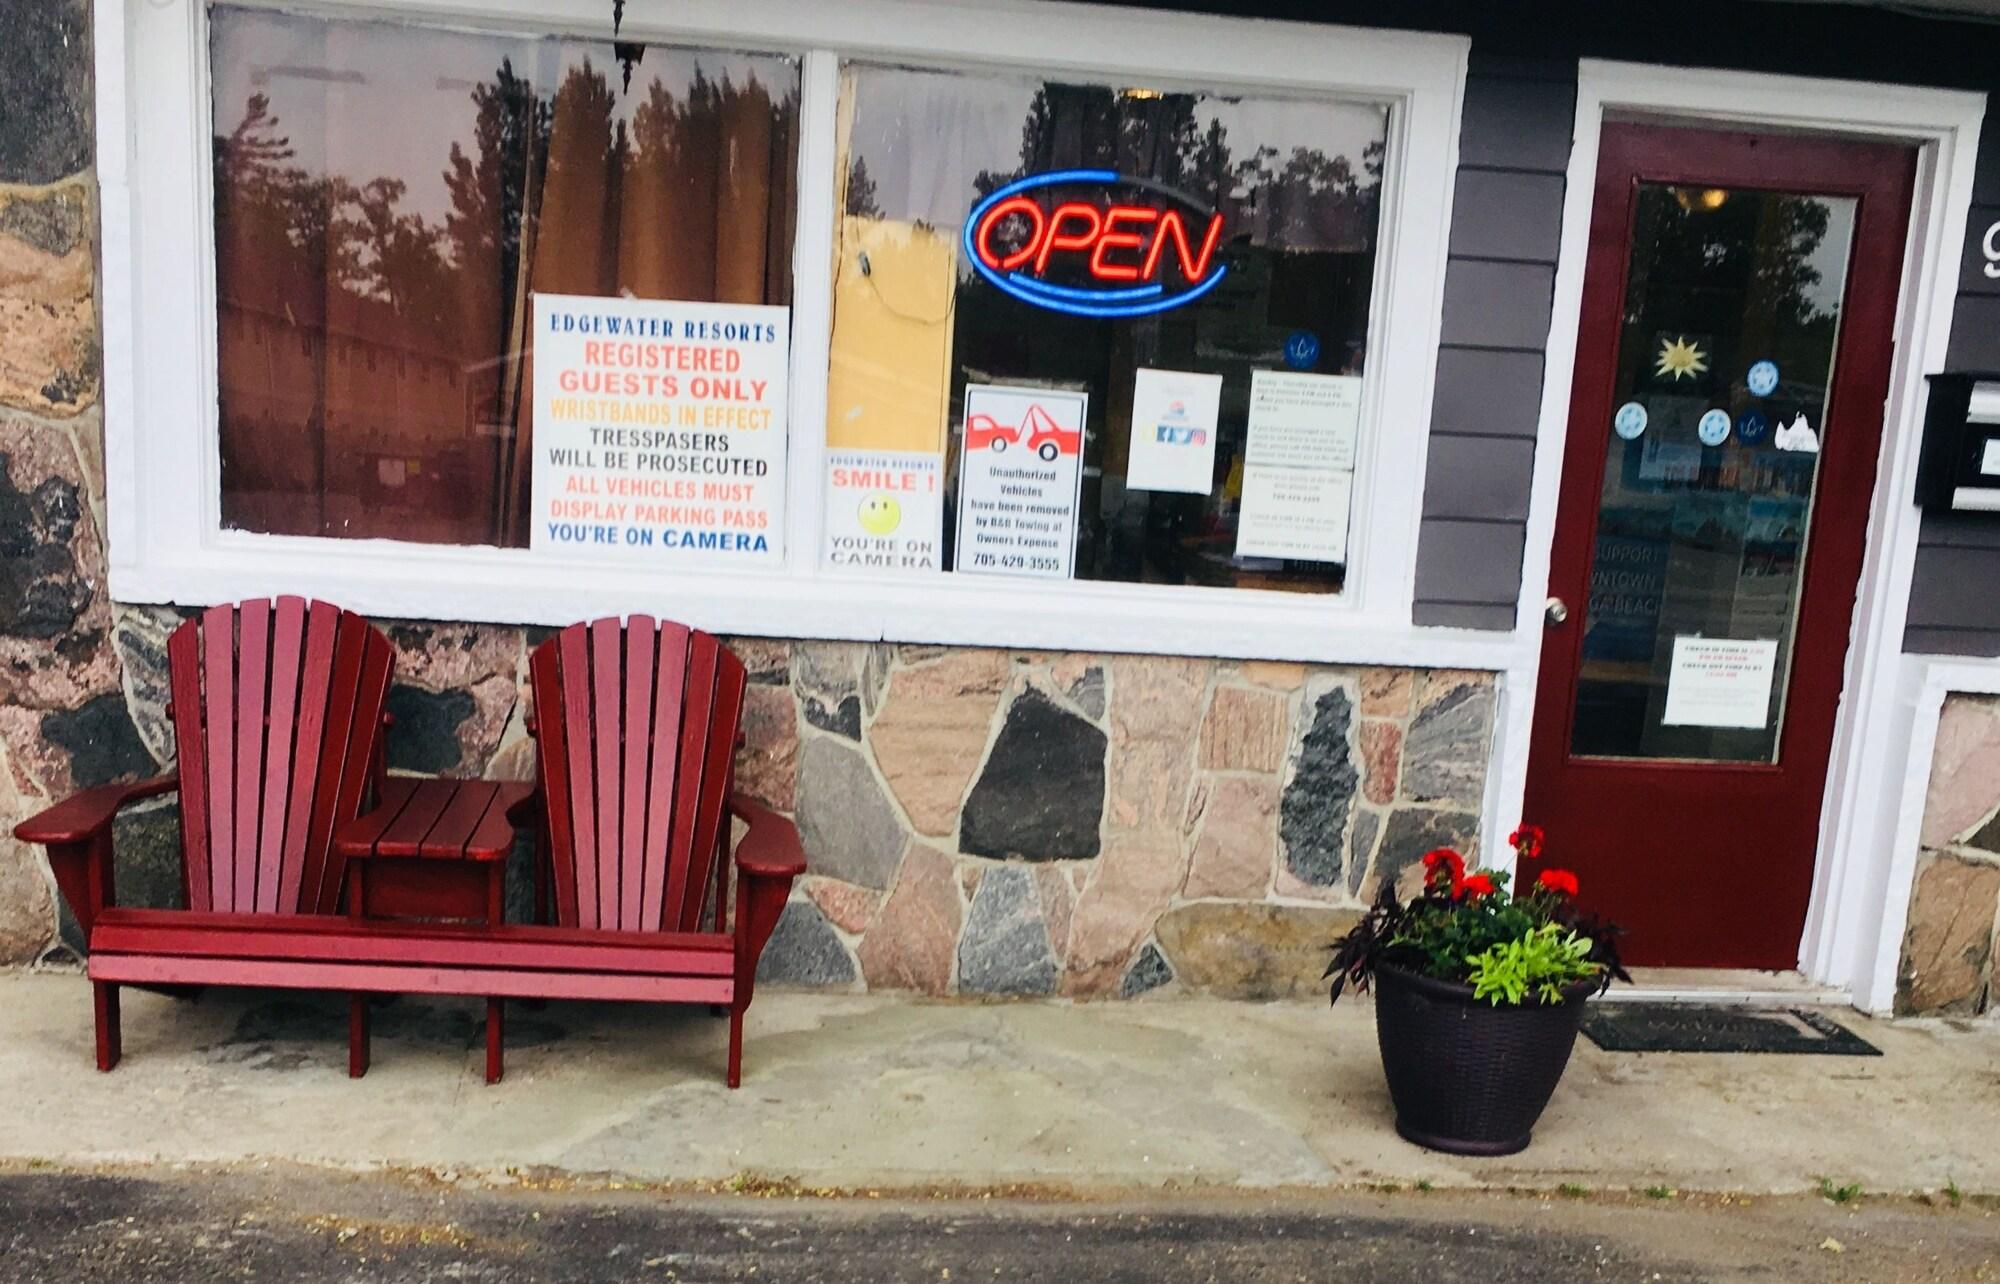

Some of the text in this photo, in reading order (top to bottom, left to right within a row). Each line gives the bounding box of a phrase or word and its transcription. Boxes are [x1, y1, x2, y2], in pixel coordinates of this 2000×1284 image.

[976, 196, 1225, 282] OPEN
[551, 313, 776, 344] EDGEWATER RESORTS
[585, 340, 741, 373] REGISTERED
[559, 369, 768, 401] GUESTS ONLY
[551, 398, 772, 430] WRISTBANDS IN EFFECT
[590, 427, 730, 452] TRESSPASERS
[549, 448, 768, 477] WILL BE PROSECUTED
[989, 466, 1057, 481] Unauthorized
[565, 474, 755, 503] ALL VEHICLES MUST
[831, 468, 918, 491] SMILE
[1000, 484, 1043, 498] Vehicles
[551, 499, 768, 529] DISPLAY PARKING PASS
[971, 499, 1070, 516] have been removed
[548, 523, 769, 552] YOU'RE ON CAMERA
[976, 517, 988, 528] by
[1014, 518, 1050, 533] Towing
[831, 536, 933, 553] YOU'RE ON
[976, 533, 1059, 549] Owners Expense
[830, 552, 933, 569] CAMERA
